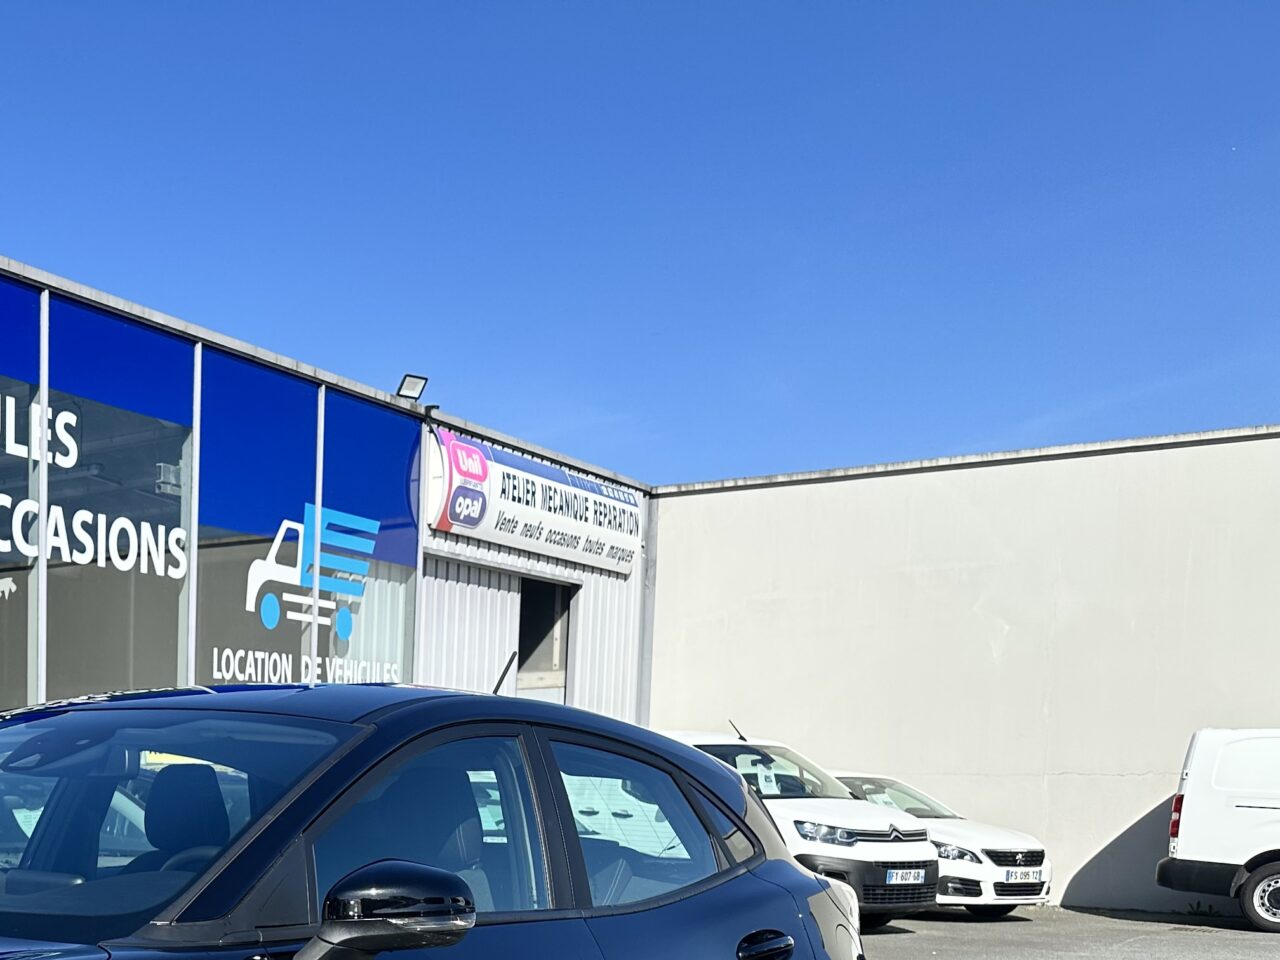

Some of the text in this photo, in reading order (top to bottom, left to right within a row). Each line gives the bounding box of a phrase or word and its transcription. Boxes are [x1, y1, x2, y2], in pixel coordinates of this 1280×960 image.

[456, 447, 483, 477] Unil
[455, 496, 483, 520] opal
[500, 471, 537, 508] ATELIER
[540, 483, 589, 523] MECANIQUE
[593, 499, 640, 538] REPARATION
[494, 510, 635, 566] Vente neufs occasions toutes marques
[213, 647, 400, 684] LOCATION DE VEHICULES
